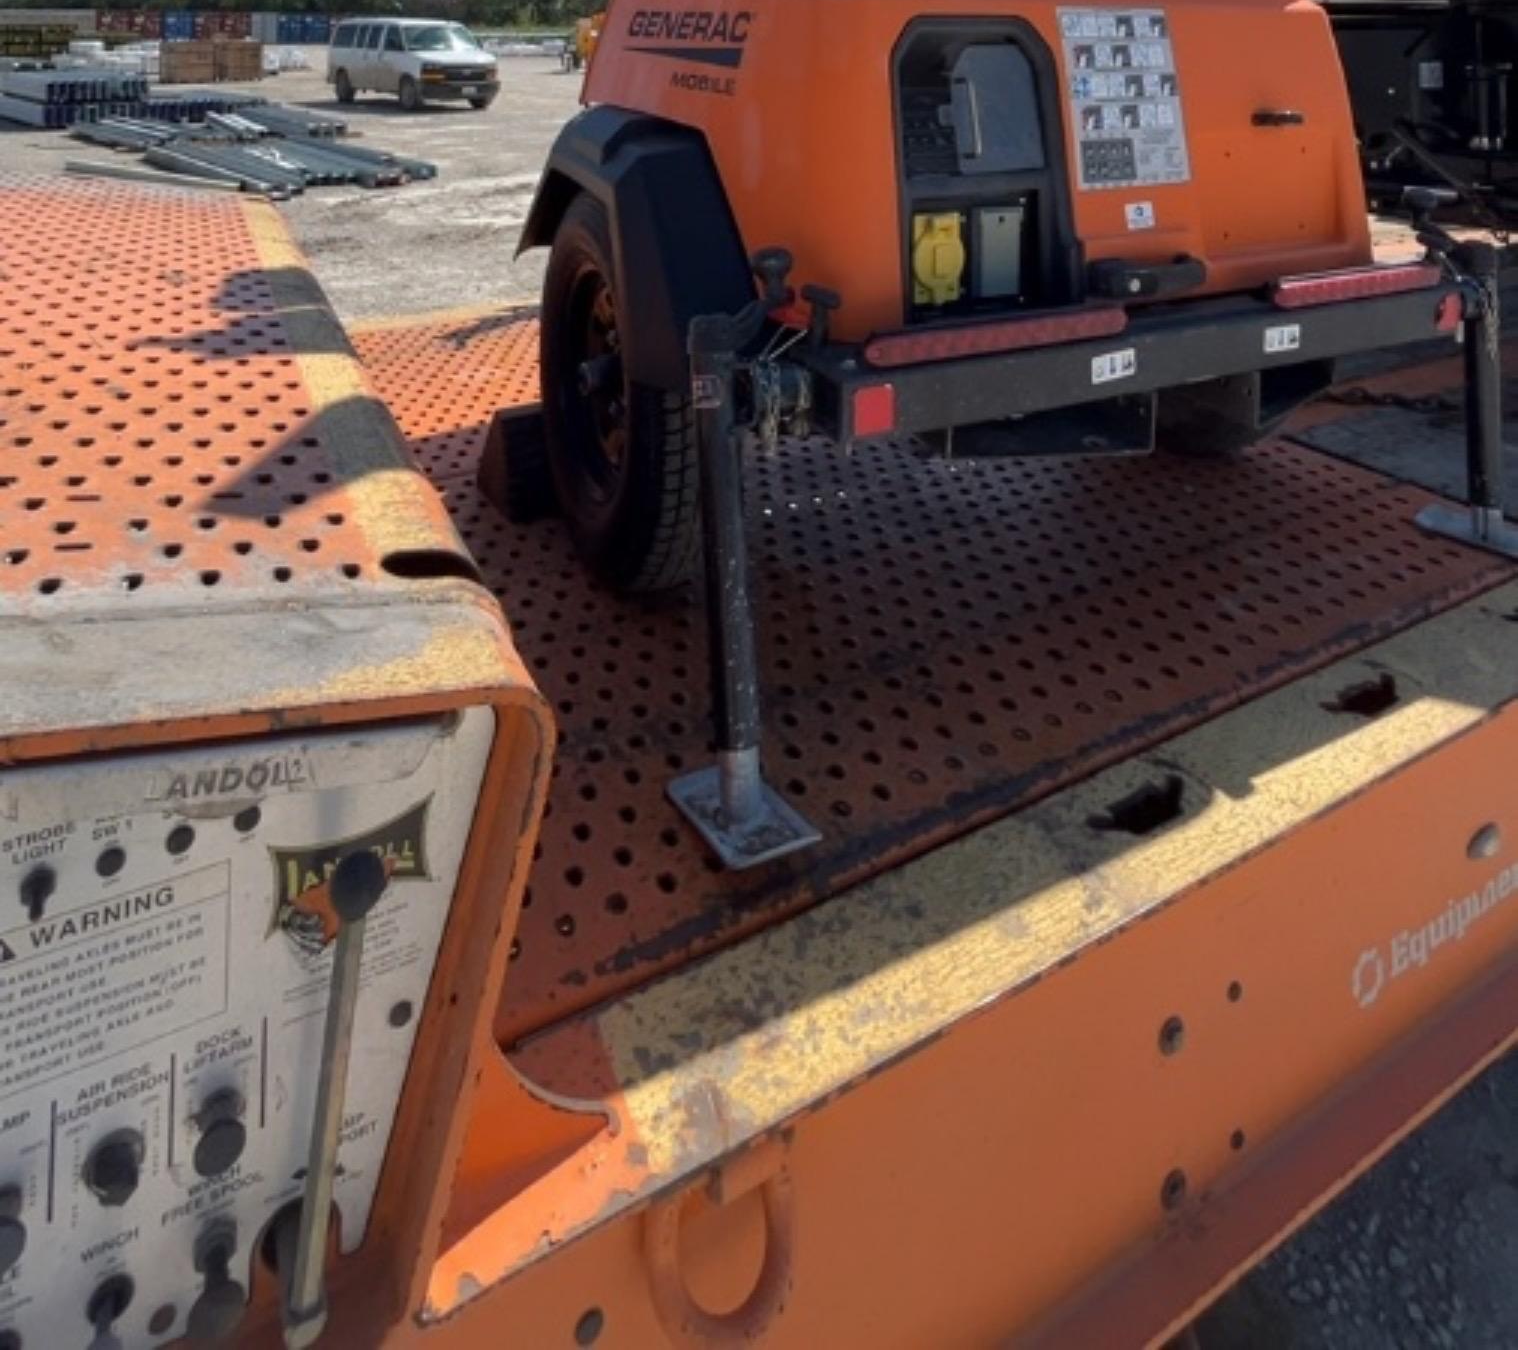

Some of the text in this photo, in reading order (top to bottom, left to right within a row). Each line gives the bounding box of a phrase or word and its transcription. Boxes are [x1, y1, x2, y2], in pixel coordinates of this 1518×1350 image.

[628, 10, 752, 43] GENERAC
[670, 71, 736, 97] MOBILE
[2, 820, 77, 853] STROBE
[12, 837, 68, 865] LIGHT
[30, 886, 176, 949] WARNING
[77, 1080, 106, 1102] AIR
[111, 1061, 153, 1089] RIDE
